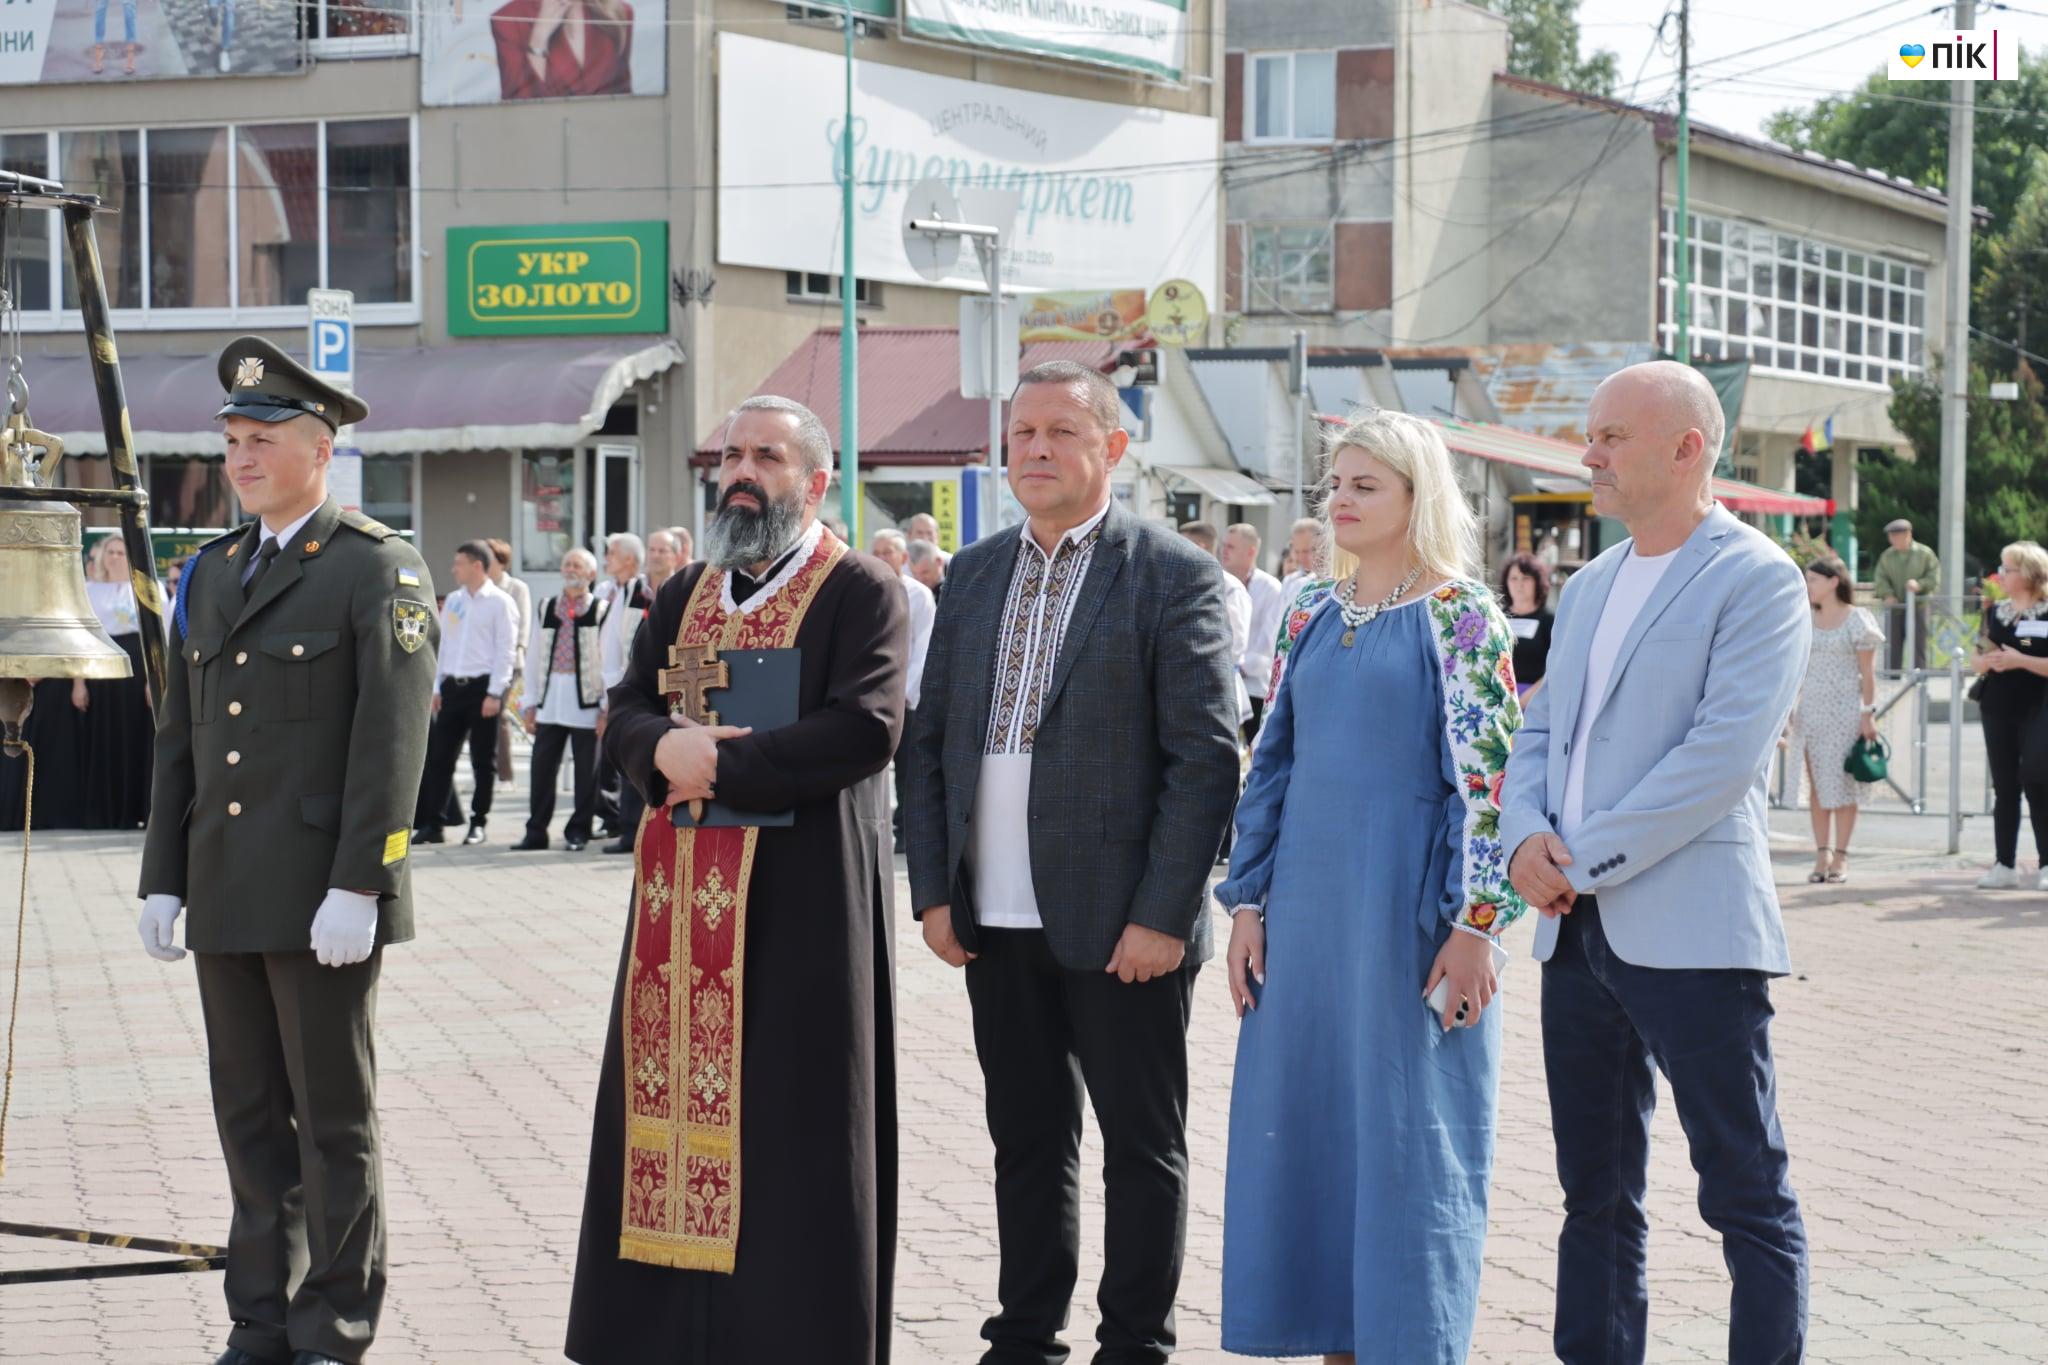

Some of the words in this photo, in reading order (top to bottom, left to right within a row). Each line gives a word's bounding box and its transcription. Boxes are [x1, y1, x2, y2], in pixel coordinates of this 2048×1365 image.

[0, 31, 33, 52] НИ
[930, 101, 1048, 156] ЦЕНТРАЛЬНИЙ
[517, 251, 590, 276] УКР
[477, 281, 632, 308] ЗОЛОТО
[314, 298, 351, 318] ЗОНА
